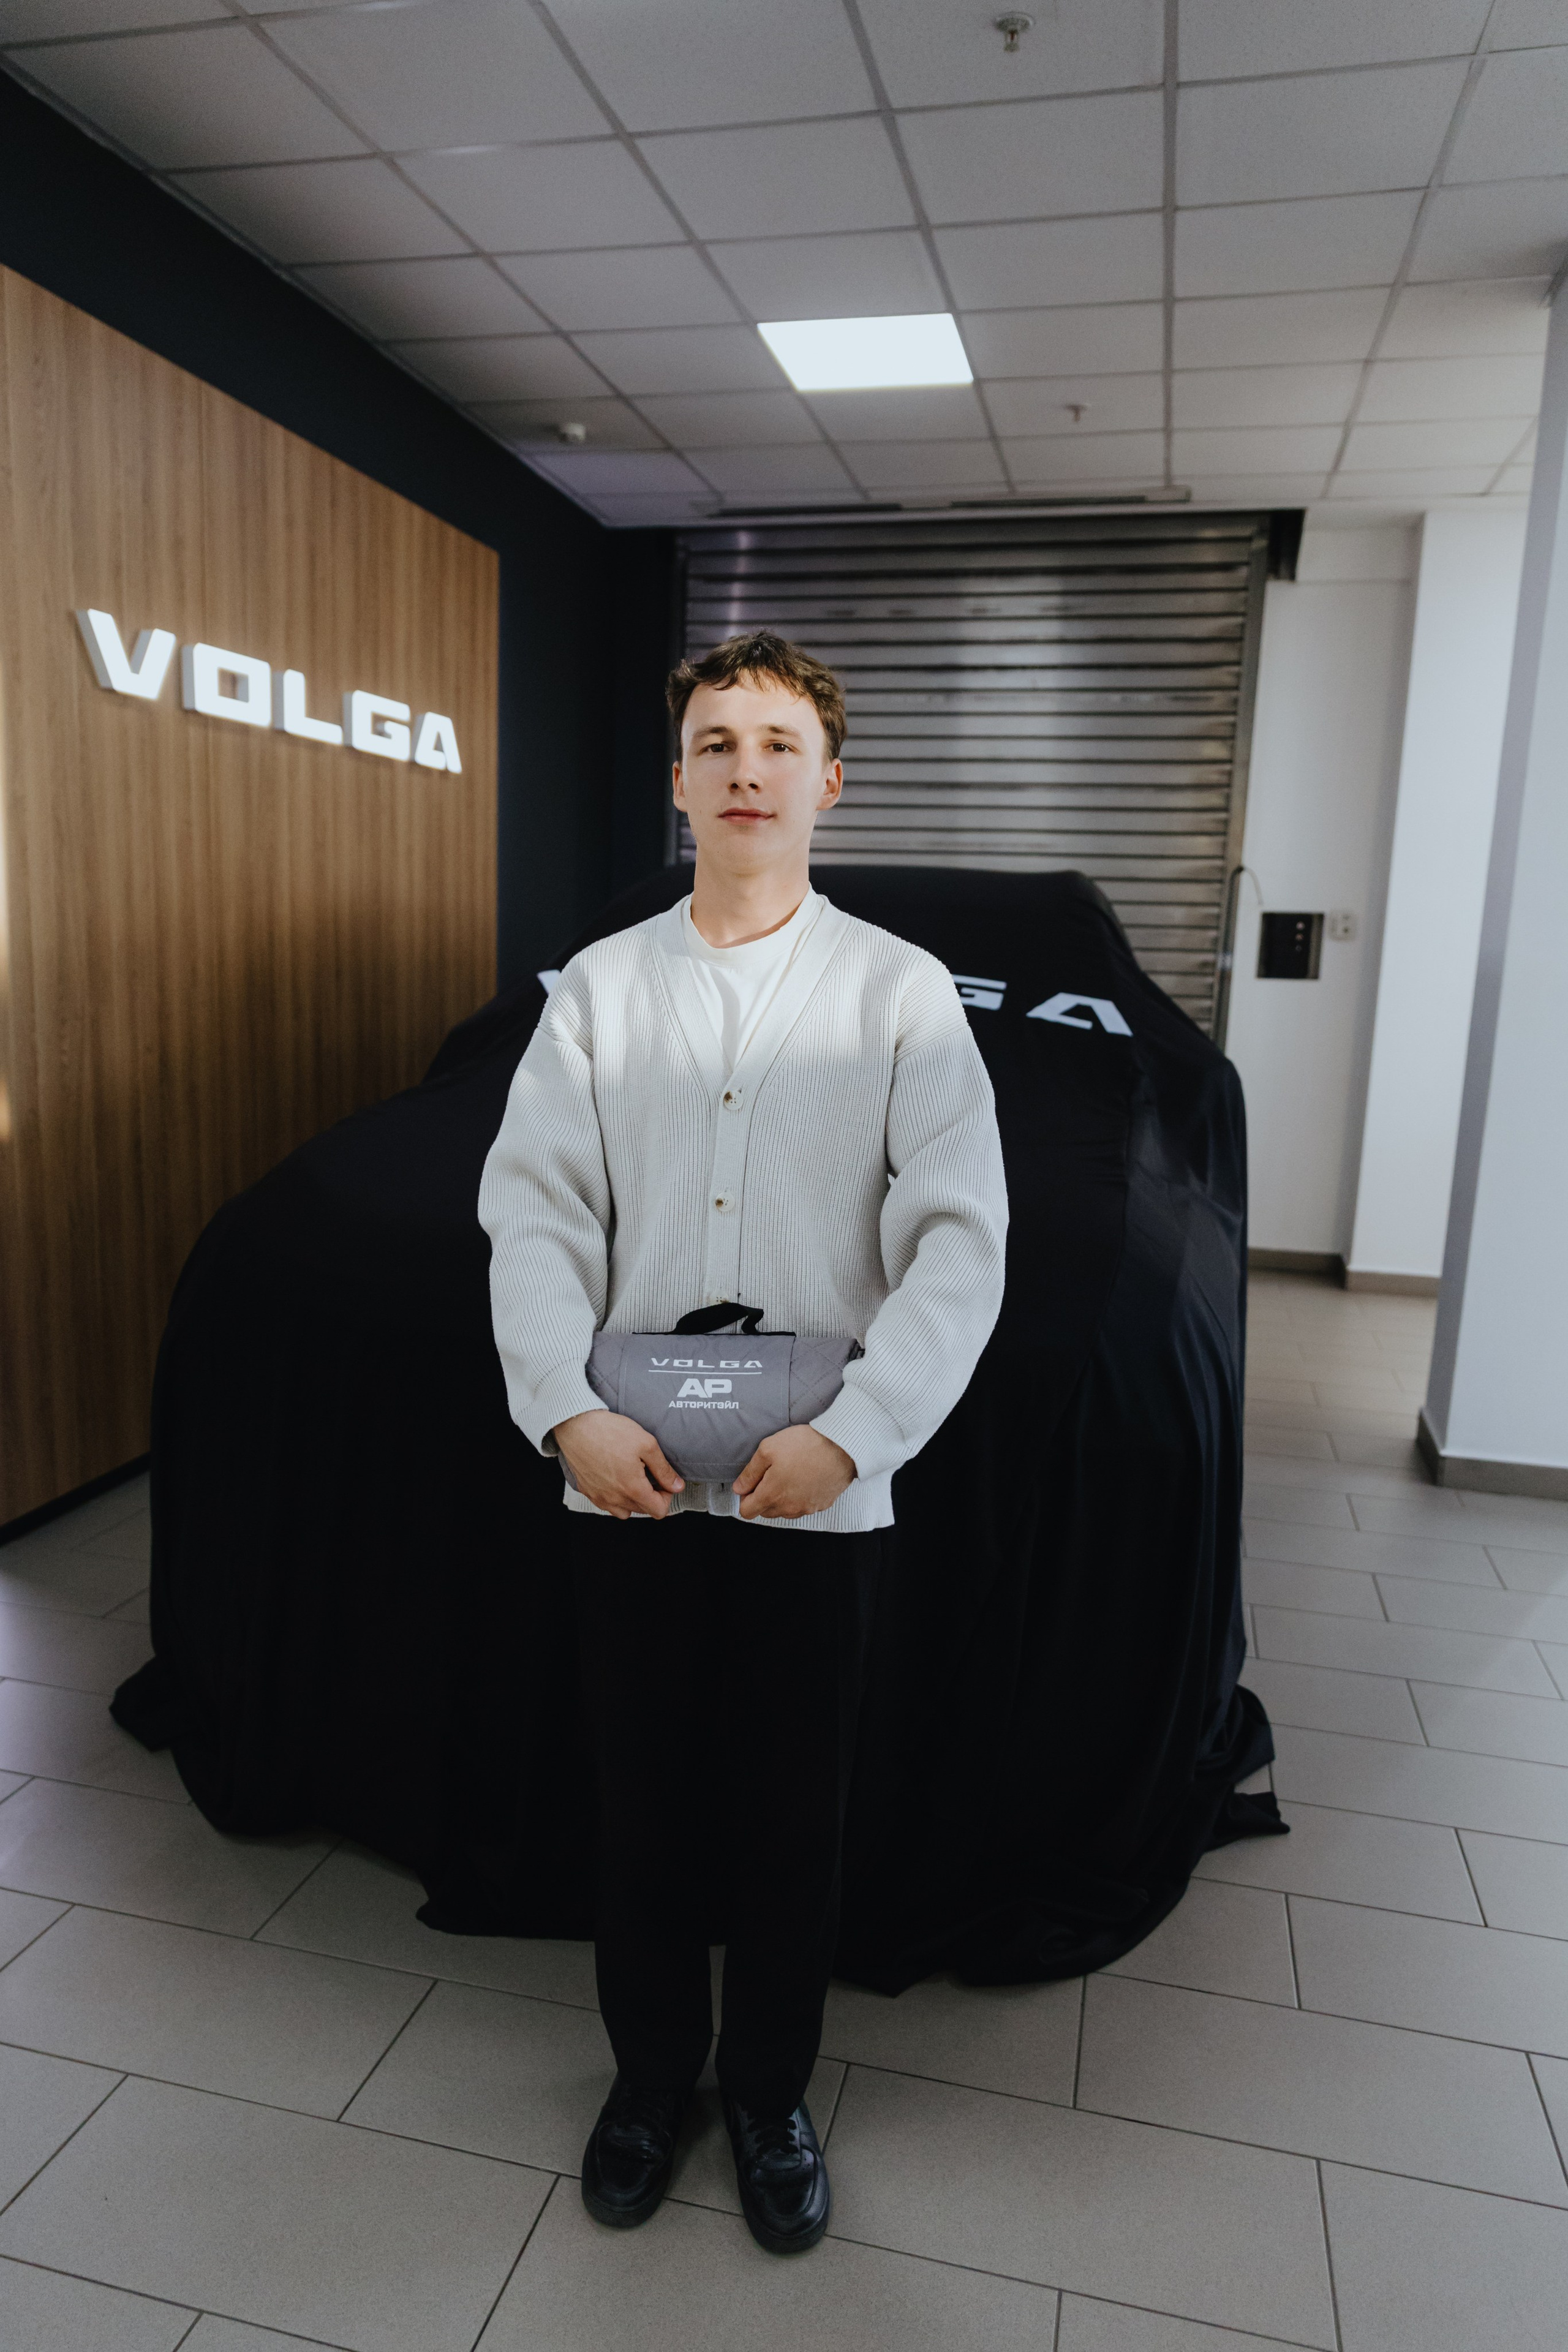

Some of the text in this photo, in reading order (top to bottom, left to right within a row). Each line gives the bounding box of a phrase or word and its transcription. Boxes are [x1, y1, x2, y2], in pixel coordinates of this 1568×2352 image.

[85, 608, 462, 774] VOLGA
[650, 1357, 763, 1368] VOLGA
[668, 1400, 739, 1409] АВТОРИТЭЙЛ
